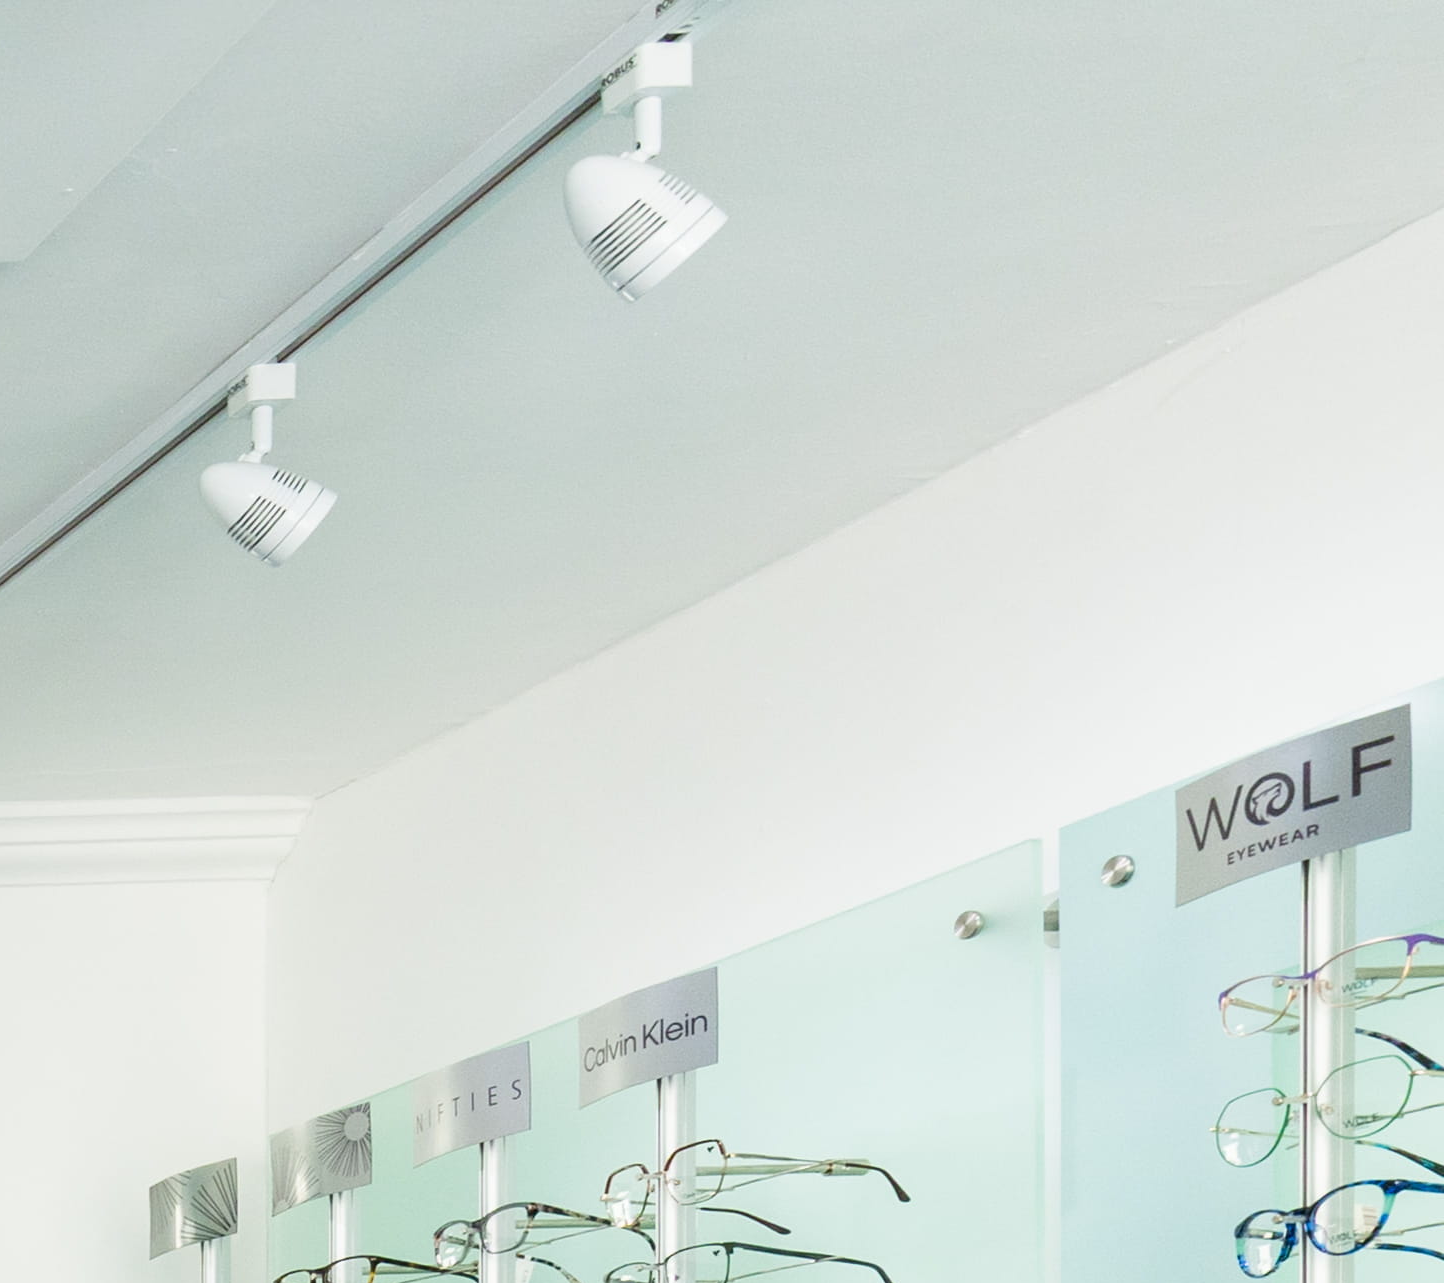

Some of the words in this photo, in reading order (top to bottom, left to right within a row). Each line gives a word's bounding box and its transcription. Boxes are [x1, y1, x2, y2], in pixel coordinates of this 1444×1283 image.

[1186, 735, 1395, 852] WOLF
[1226, 824, 1320, 866] EYEWEAR
[583, 1033, 637, 1072] Calvin
[642, 1013, 709, 1049] Klein
[415, 1079, 523, 1135] NIFTIES
